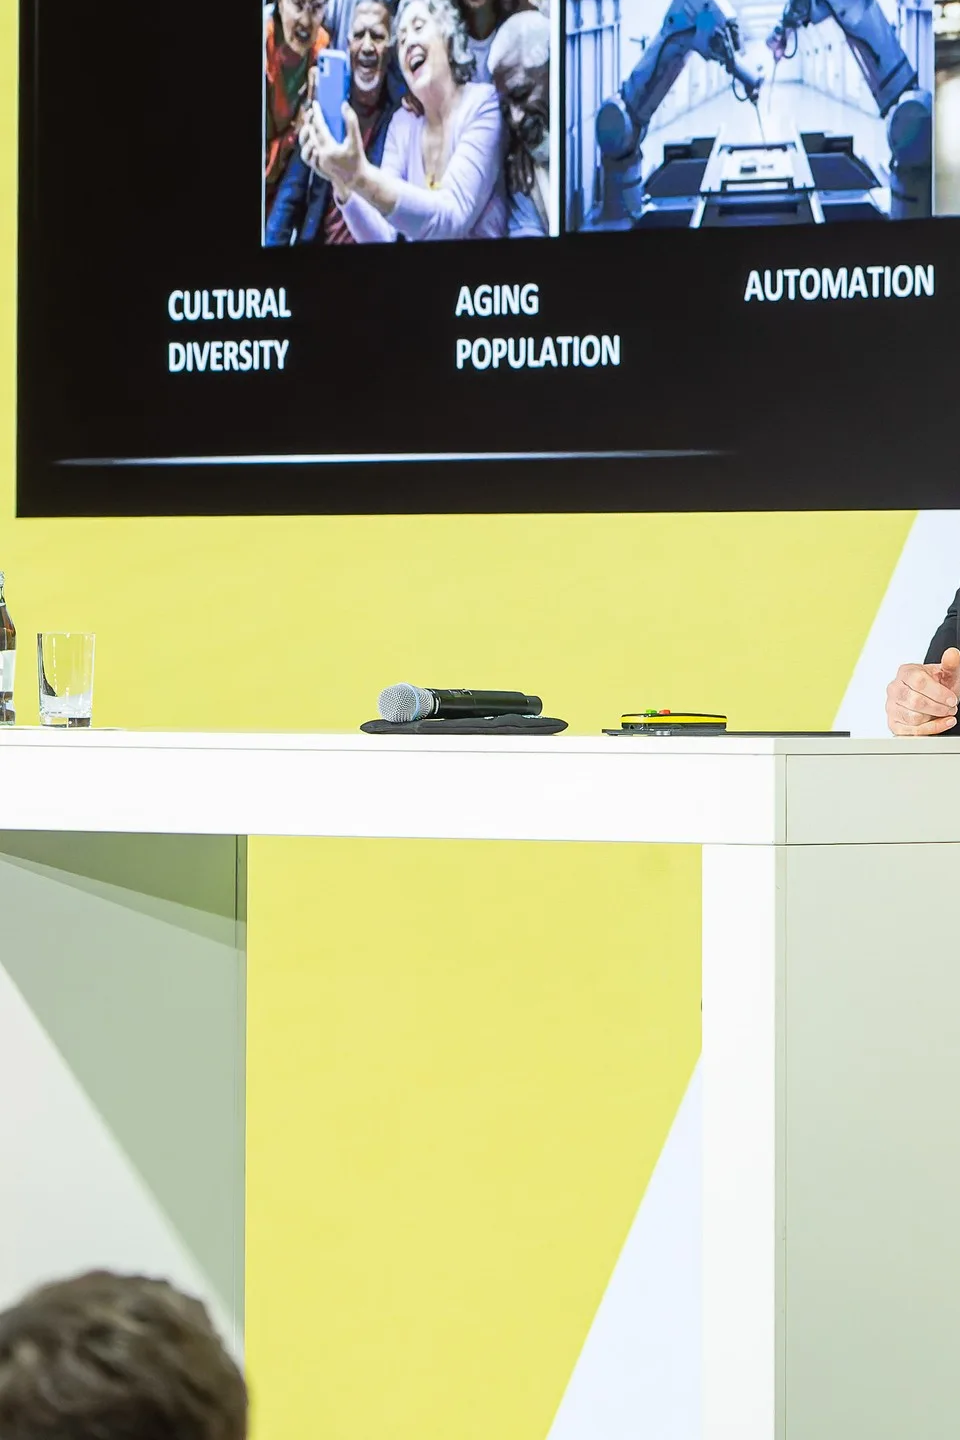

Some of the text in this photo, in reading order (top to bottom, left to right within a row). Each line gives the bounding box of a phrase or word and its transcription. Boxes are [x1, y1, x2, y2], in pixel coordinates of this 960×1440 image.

[454, 282, 539, 317] AGING
[743, 264, 935, 302] AUTOMATION
[167, 287, 292, 321] CULTURAL
[168, 339, 290, 372] DIVERSITY
[456, 334, 621, 370] POPULATION
